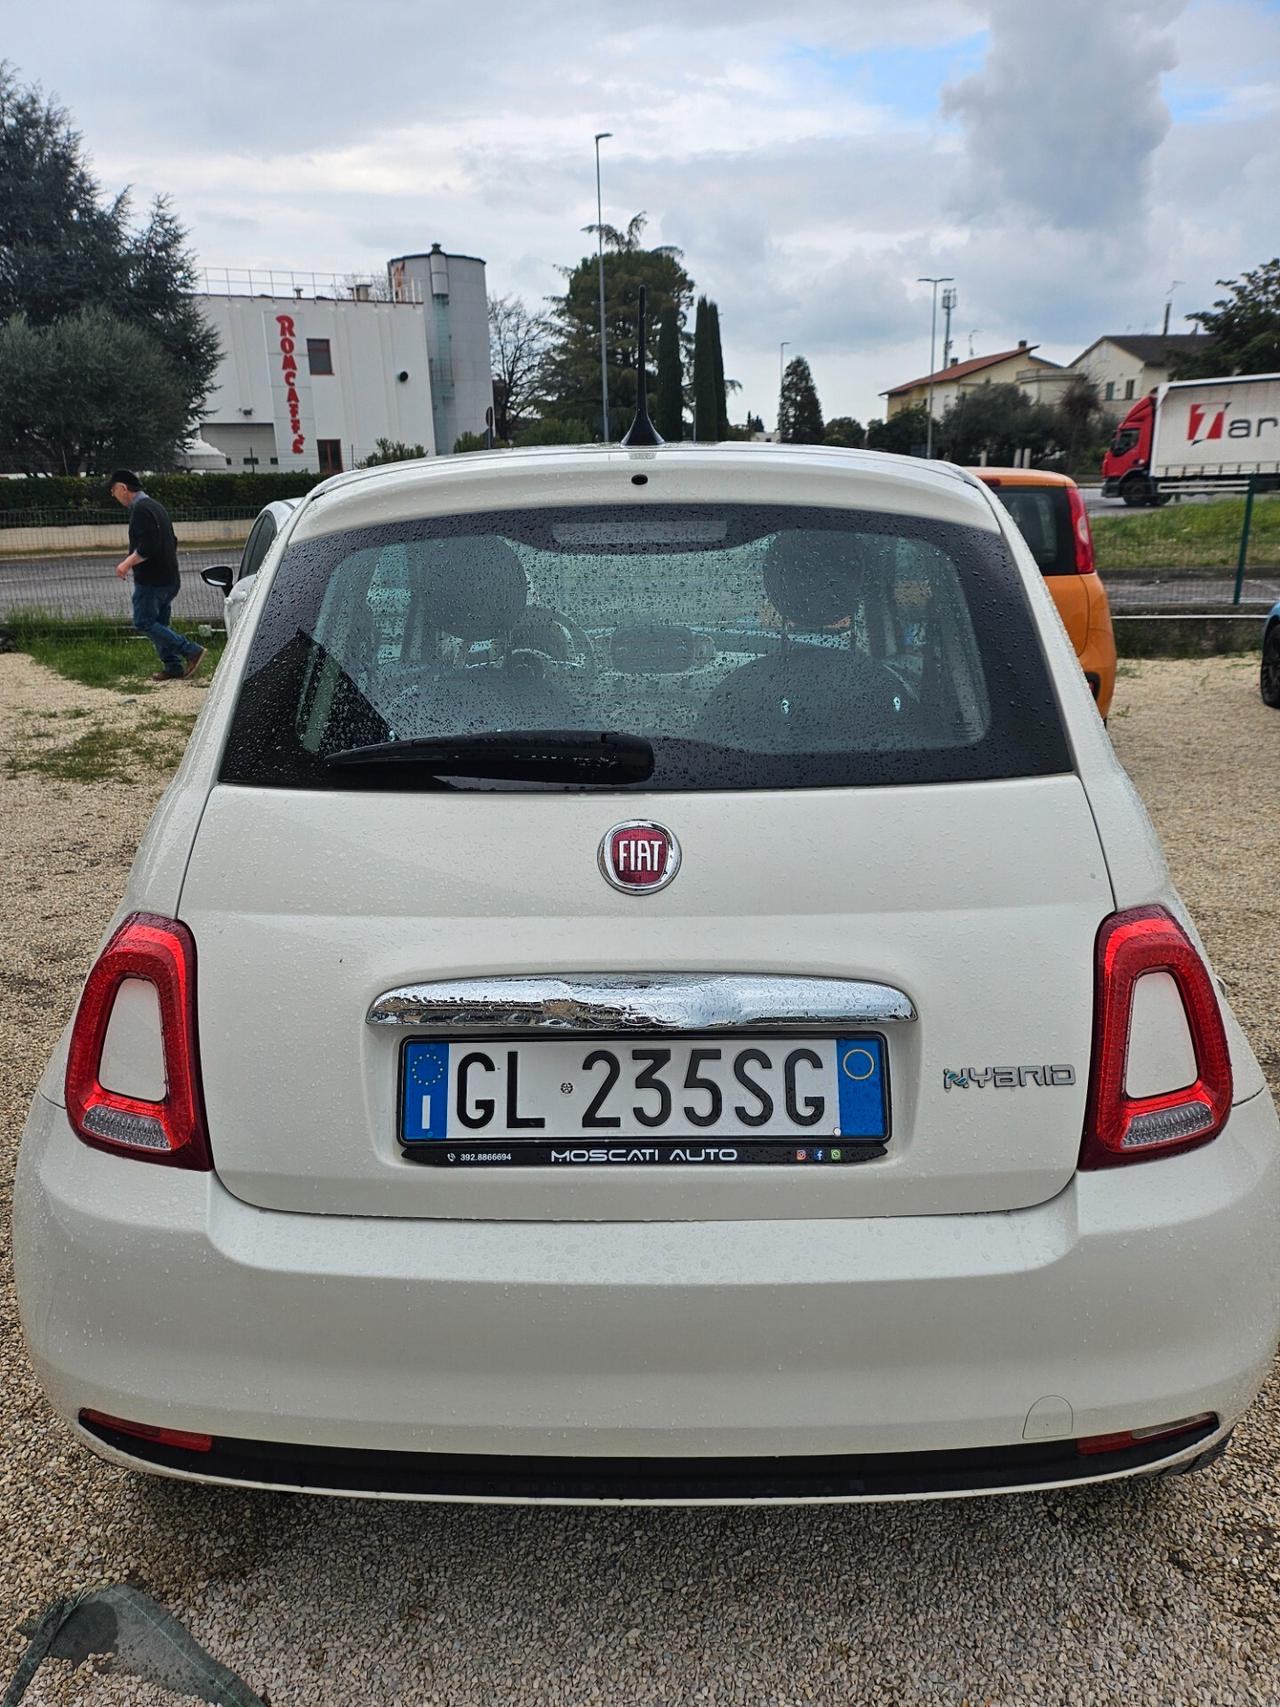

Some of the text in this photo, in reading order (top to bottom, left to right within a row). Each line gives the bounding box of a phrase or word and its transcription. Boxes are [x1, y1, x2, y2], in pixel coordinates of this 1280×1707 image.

[618, 840, 663, 872] FIAT
[456, 1047, 825, 1130] GL 235SG
[550, 1148, 738, 1163] MOSCATI AUTO
